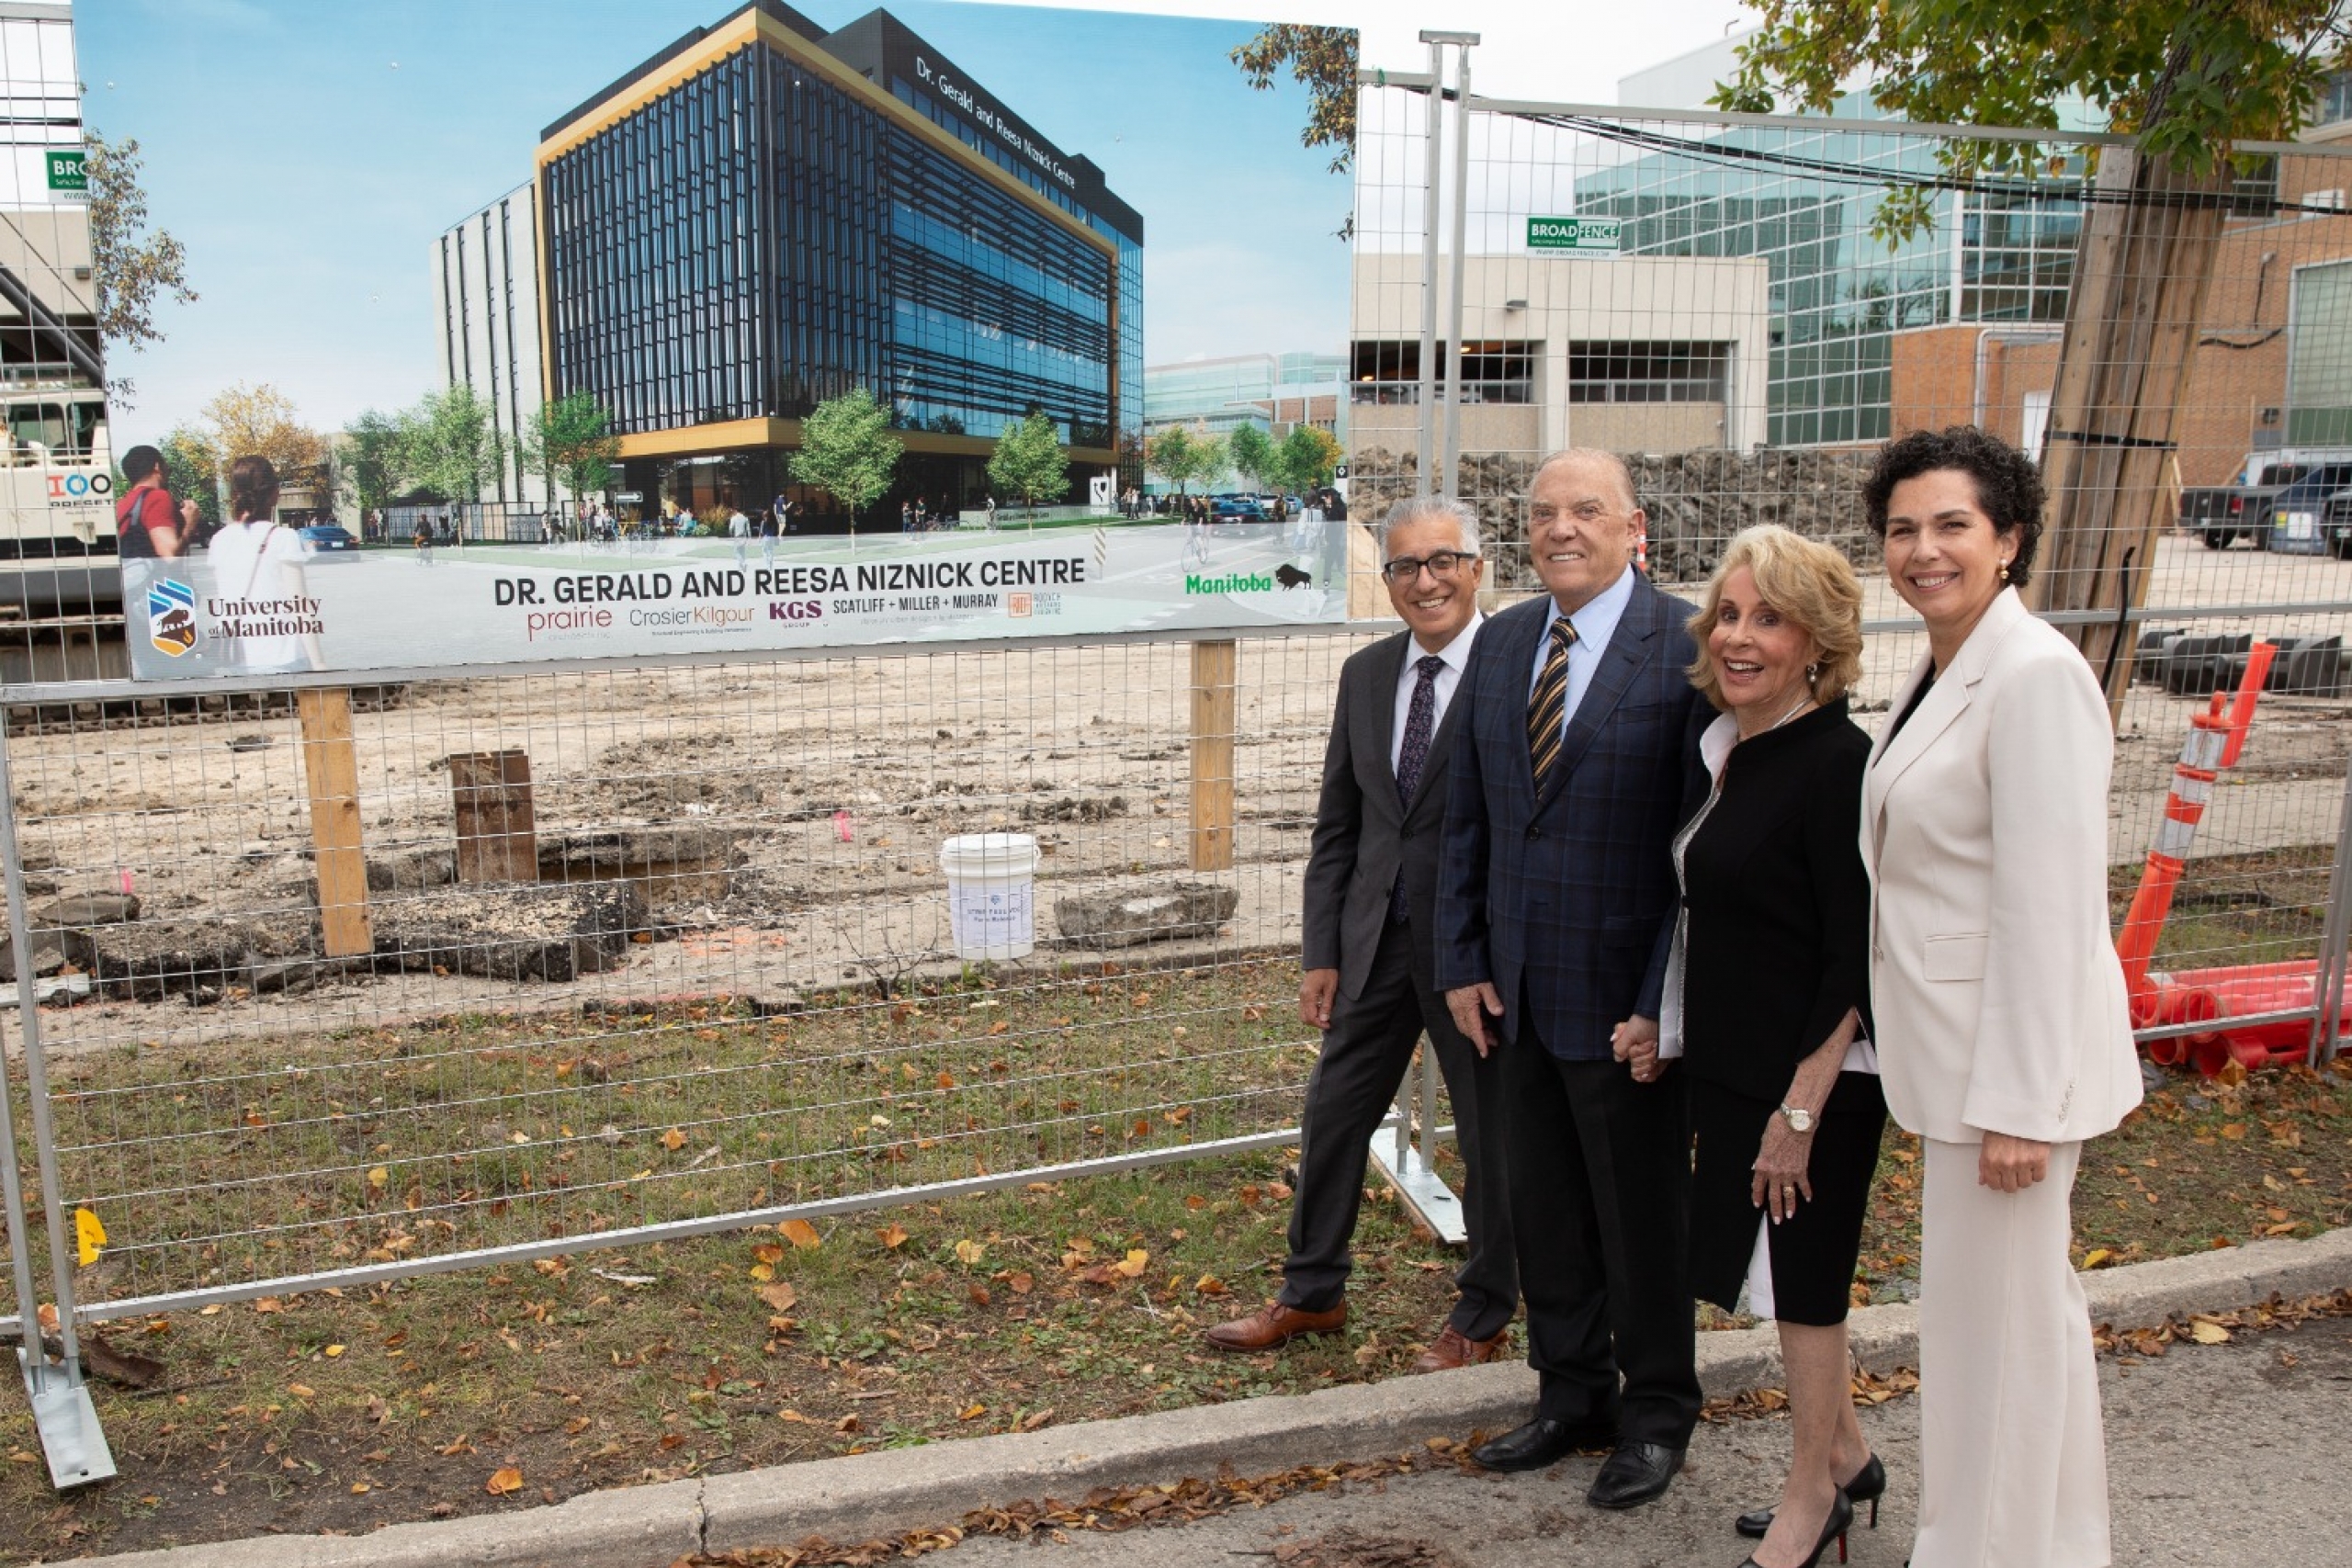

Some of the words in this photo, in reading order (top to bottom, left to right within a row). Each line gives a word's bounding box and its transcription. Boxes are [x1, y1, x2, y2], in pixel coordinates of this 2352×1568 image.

[916, 56, 935, 85] Dr.
[939, 74, 973, 113] Gerald
[976, 105, 993, 129] and
[997, 117, 1022, 149] Reesa
[1053, 161, 1075, 189] Centre
[1532, 224, 1616, 238] BROADFENCE
[494, 578, 546, 605] DR.
[554, 573, 673, 604] GERALD
[681, 570, 745, 598] AND
[754, 567, 849, 595] REESA
[857, 562, 973, 592] NIZNICK
[979, 558, 1085, 586] CENTRE
[1186, 572, 1272, 594] Manitoba
[207, 594, 322, 617] University
[769, 600, 822, 620] KGS
[833, 598, 885, 614] SCATLIFF
[899, 595, 940, 611] MILLER
[953, 593, 998, 609] MURRAY
[208, 626, 220, 638] of
[220, 615, 324, 638] Manitoba
[527, 604, 613, 641] prairie
